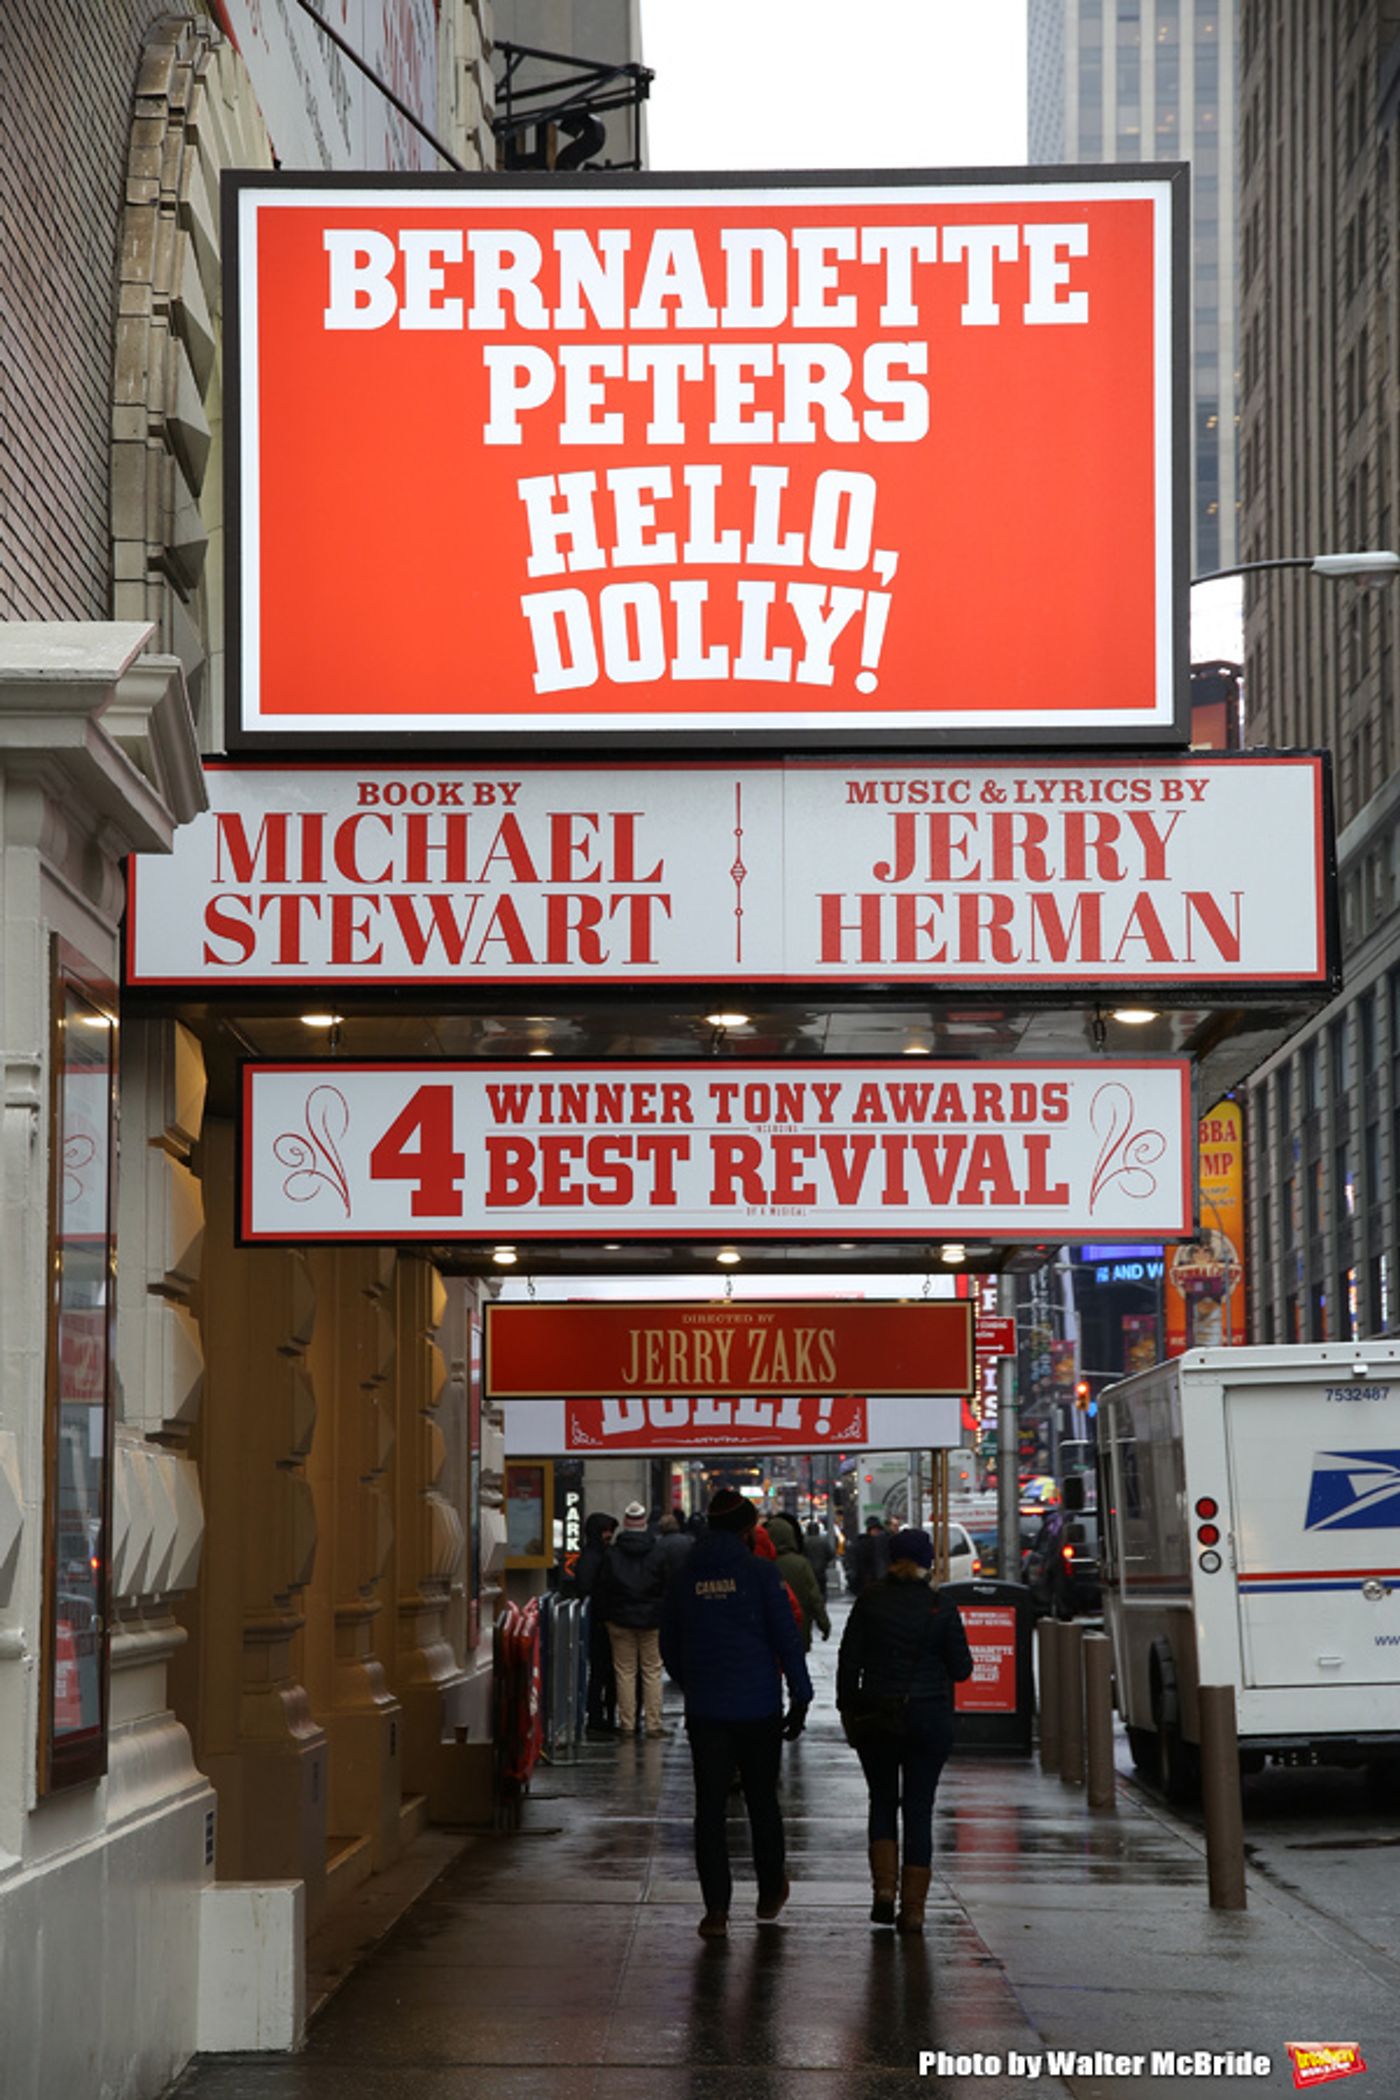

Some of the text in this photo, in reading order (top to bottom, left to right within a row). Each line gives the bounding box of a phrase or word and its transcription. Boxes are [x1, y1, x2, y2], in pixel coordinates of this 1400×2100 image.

[323, 224, 1089, 330] BERNADETTE
[483, 341, 930, 445] PETERS
[517, 464, 899, 587] HELLO,
[520, 579, 892, 695] DOLLY!
[357, 782, 521, 806] BOOK BY
[845, 778, 1210, 804] MUSIC & LYRICS BY
[212, 812, 665, 884] MICHAEL
[872, 810, 1186, 883] JERRY
[203, 893, 672, 966] STEWART
[815, 890, 1244, 964] HERMAN
[485, 1082, 1069, 1124] WINNER TONY AWARDS
[369, 1084, 466, 1217] 4
[485, 1134, 1070, 1207] BEST REVIVAL
[1199, 1153, 1234, 1176] MP
[1112, 1263, 1145, 1282] AND
[682, 1313, 775, 1324] DIRECTED BY
[622, 1328, 837, 1384] JERRY ZAKS
[1325, 1386, 1391, 1402] 7532487
[566, 1492, 580, 1551] PARK
[695, 1578, 736, 1595] CANADA
